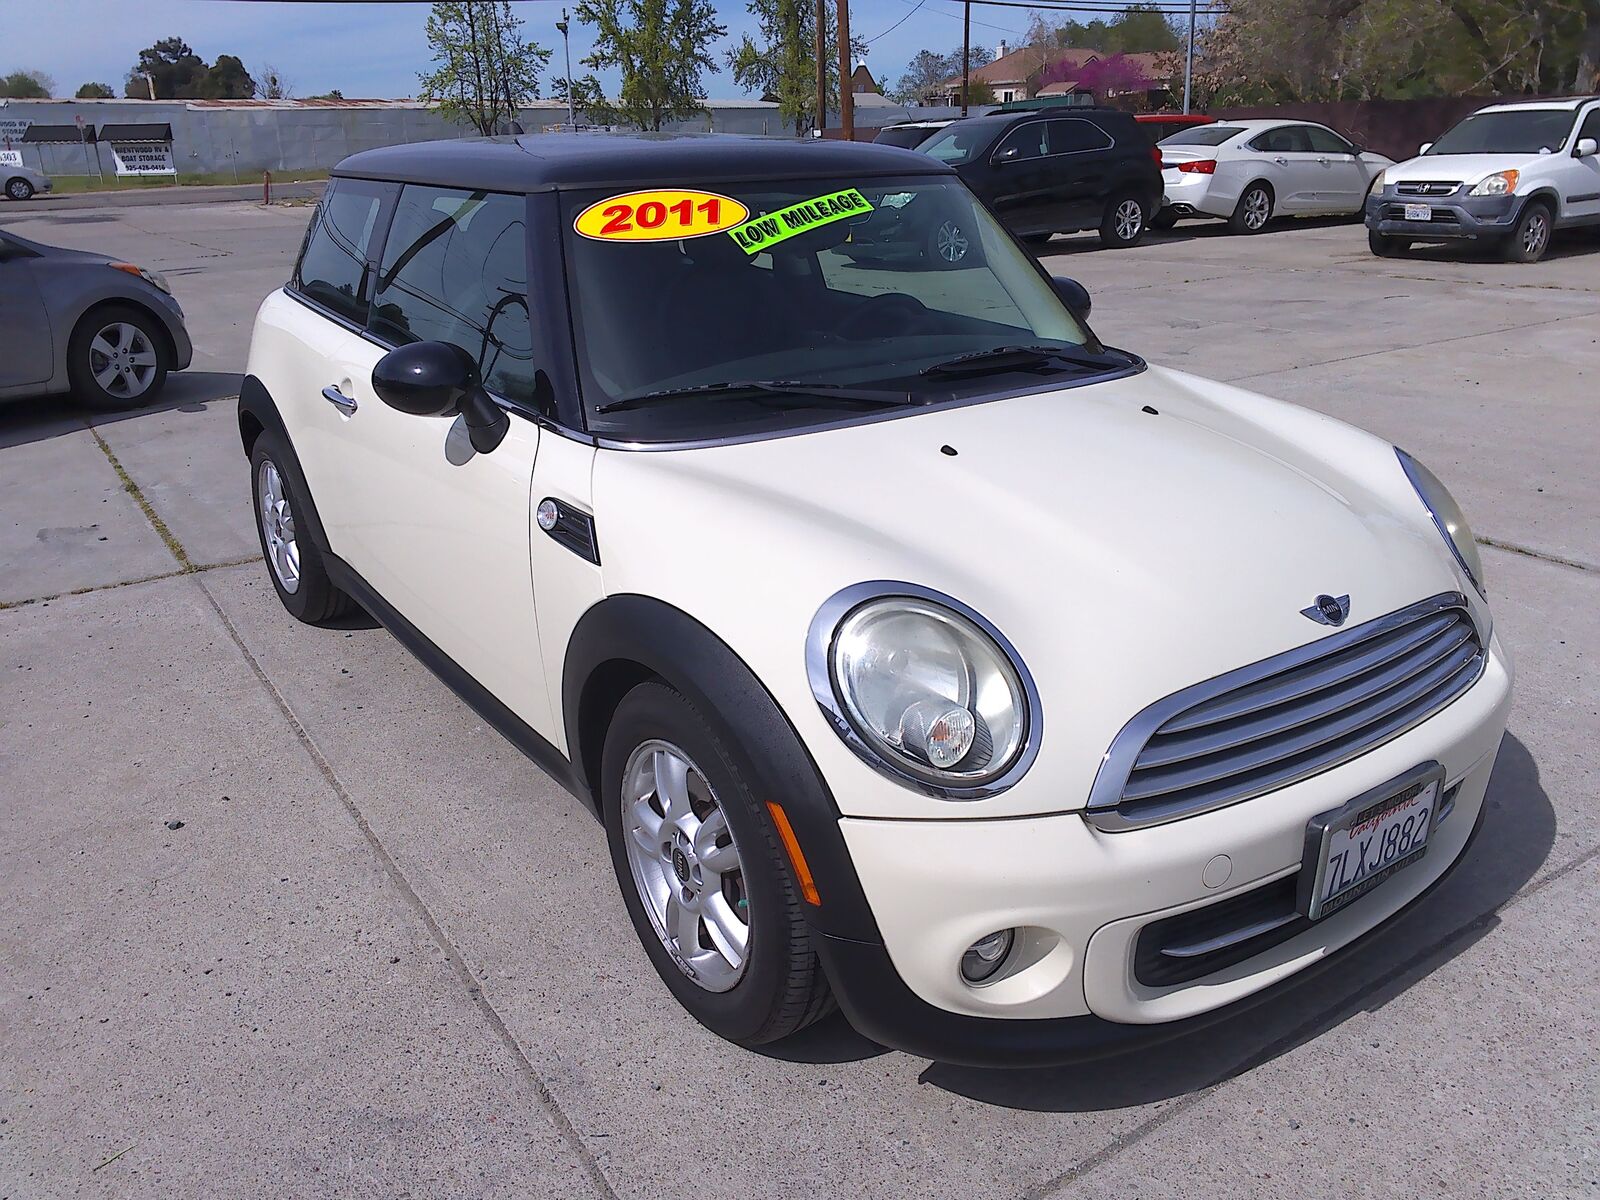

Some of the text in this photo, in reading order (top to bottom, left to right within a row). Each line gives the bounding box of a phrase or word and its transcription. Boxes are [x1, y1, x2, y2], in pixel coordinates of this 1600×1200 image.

[600, 198, 721, 235] 2011
[733, 191, 865, 249] LOW MILEAGE
[1328, 807, 1429, 899] 7LXJ882
